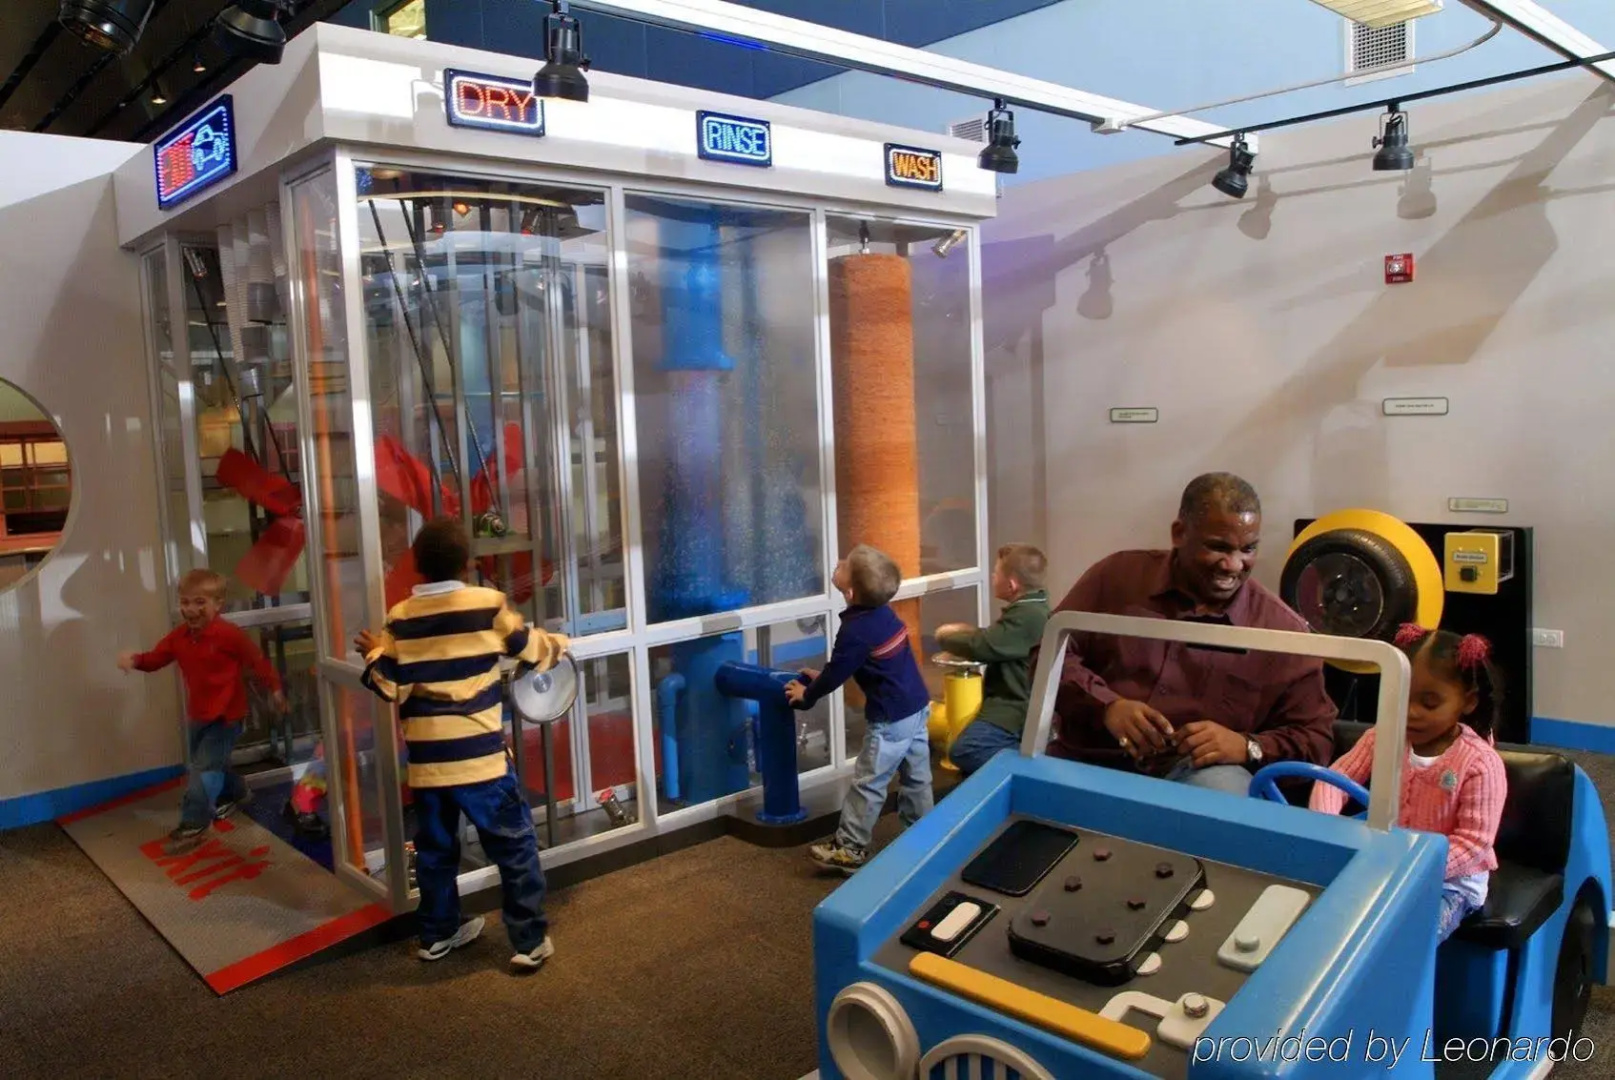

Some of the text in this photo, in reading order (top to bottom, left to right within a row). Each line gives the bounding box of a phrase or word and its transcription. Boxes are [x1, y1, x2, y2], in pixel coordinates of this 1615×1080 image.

[459, 82, 533, 121] DRY
[708, 121, 766, 155] RINSE
[893, 152, 939, 181] WASH
